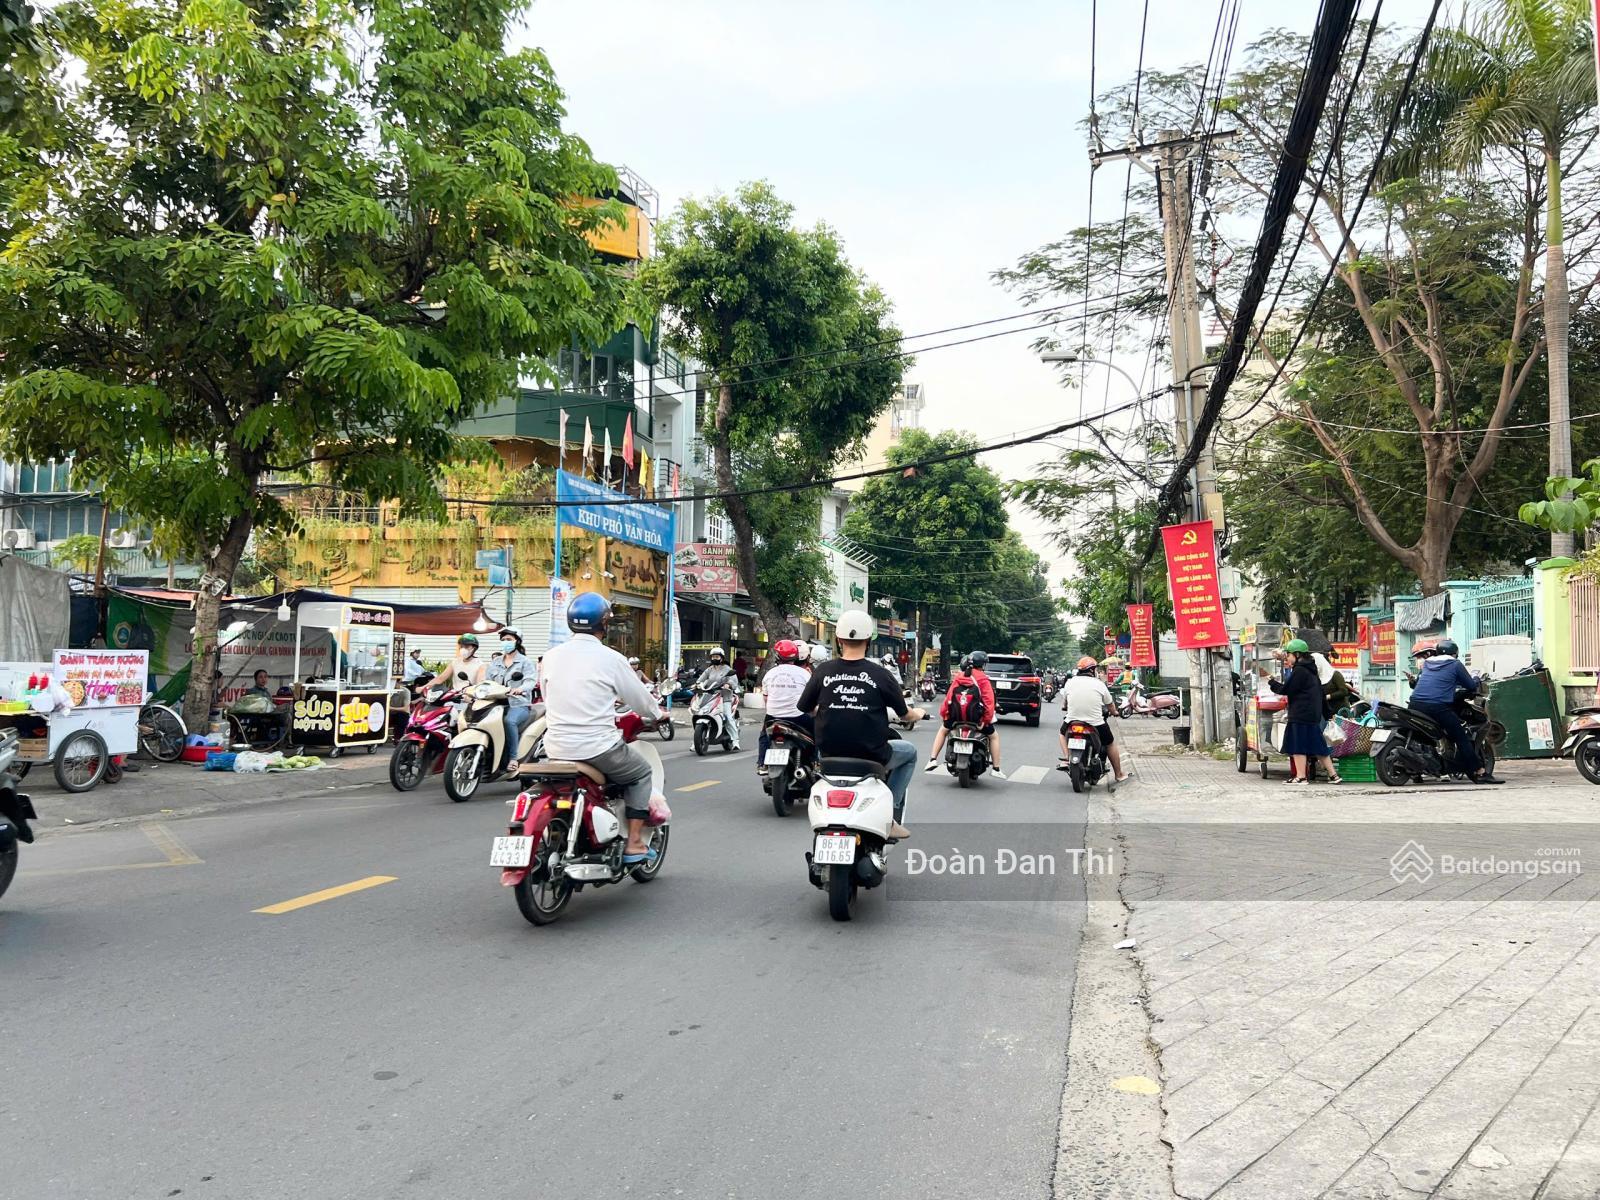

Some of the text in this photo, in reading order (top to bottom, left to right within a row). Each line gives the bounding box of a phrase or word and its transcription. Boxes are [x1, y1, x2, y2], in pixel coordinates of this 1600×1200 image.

[578, 507, 600, 528] KHU
[602, 515, 622, 534] PHỐ
[625, 523, 642, 540] VĂN
[644, 529, 662, 546] HÓA
[60, 651, 85, 666] BÁNH
[87, 652, 115, 665] TRÁNG
[823, 671, 877, 688] Christian Dior
[833, 685, 865, 694] Atelier
[840, 694, 857, 702] Paris
[294, 694, 334, 718] SÚP
[340, 696, 370, 723] SÚP
[822, 838, 850, 850] 86-AM
[818, 850, 851, 862] 016.65
